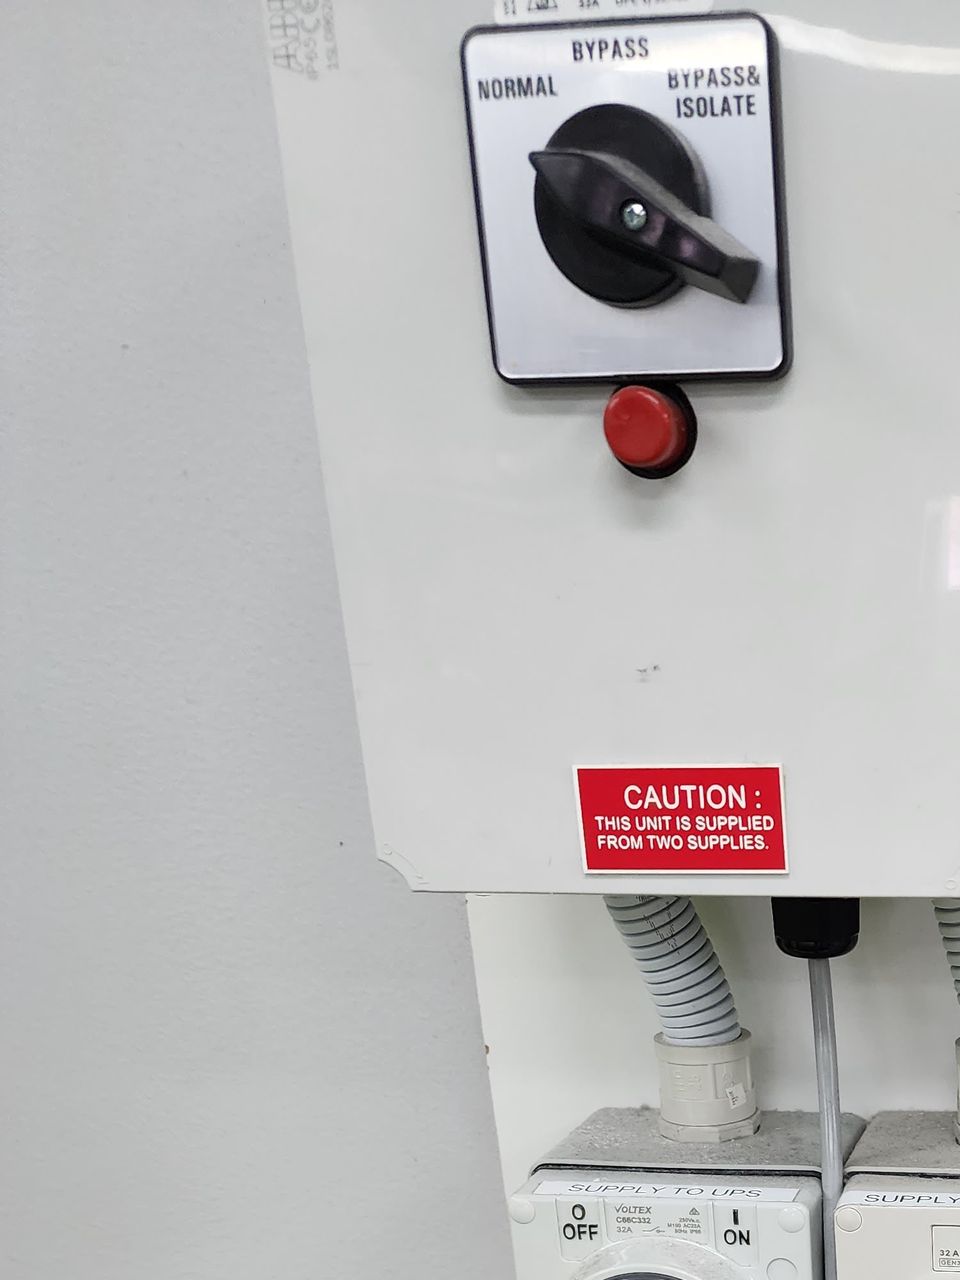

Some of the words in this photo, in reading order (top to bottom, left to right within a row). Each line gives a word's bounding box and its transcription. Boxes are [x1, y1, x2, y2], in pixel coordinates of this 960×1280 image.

[572, 38, 649, 62] BYPASS
[668, 65, 760, 89] BYPASS&
[478, 75, 558, 100] NORMAL
[676, 95, 756, 118] ISOLATE
[623, 784, 747, 810] CAUTION
[595, 815, 632, 831] THIS
[635, 815, 672, 831] UNIT
[676, 815, 691, 831] IS
[695, 815, 775, 831] SUPPLIED
[597, 835, 643, 850] FROM
[646, 835, 683, 850] TWO
[687, 835, 769, 850] SUPPLIES.
[568, 1184, 666, 1195] SUPPLY
[674, 1187, 704, 1196] TO
[711, 1188, 762, 1198] UPS
[615, 1203, 652, 1214] VOLTEX
[563, 1223, 598, 1241] OFF
[724, 1229, 750, 1245] ON
